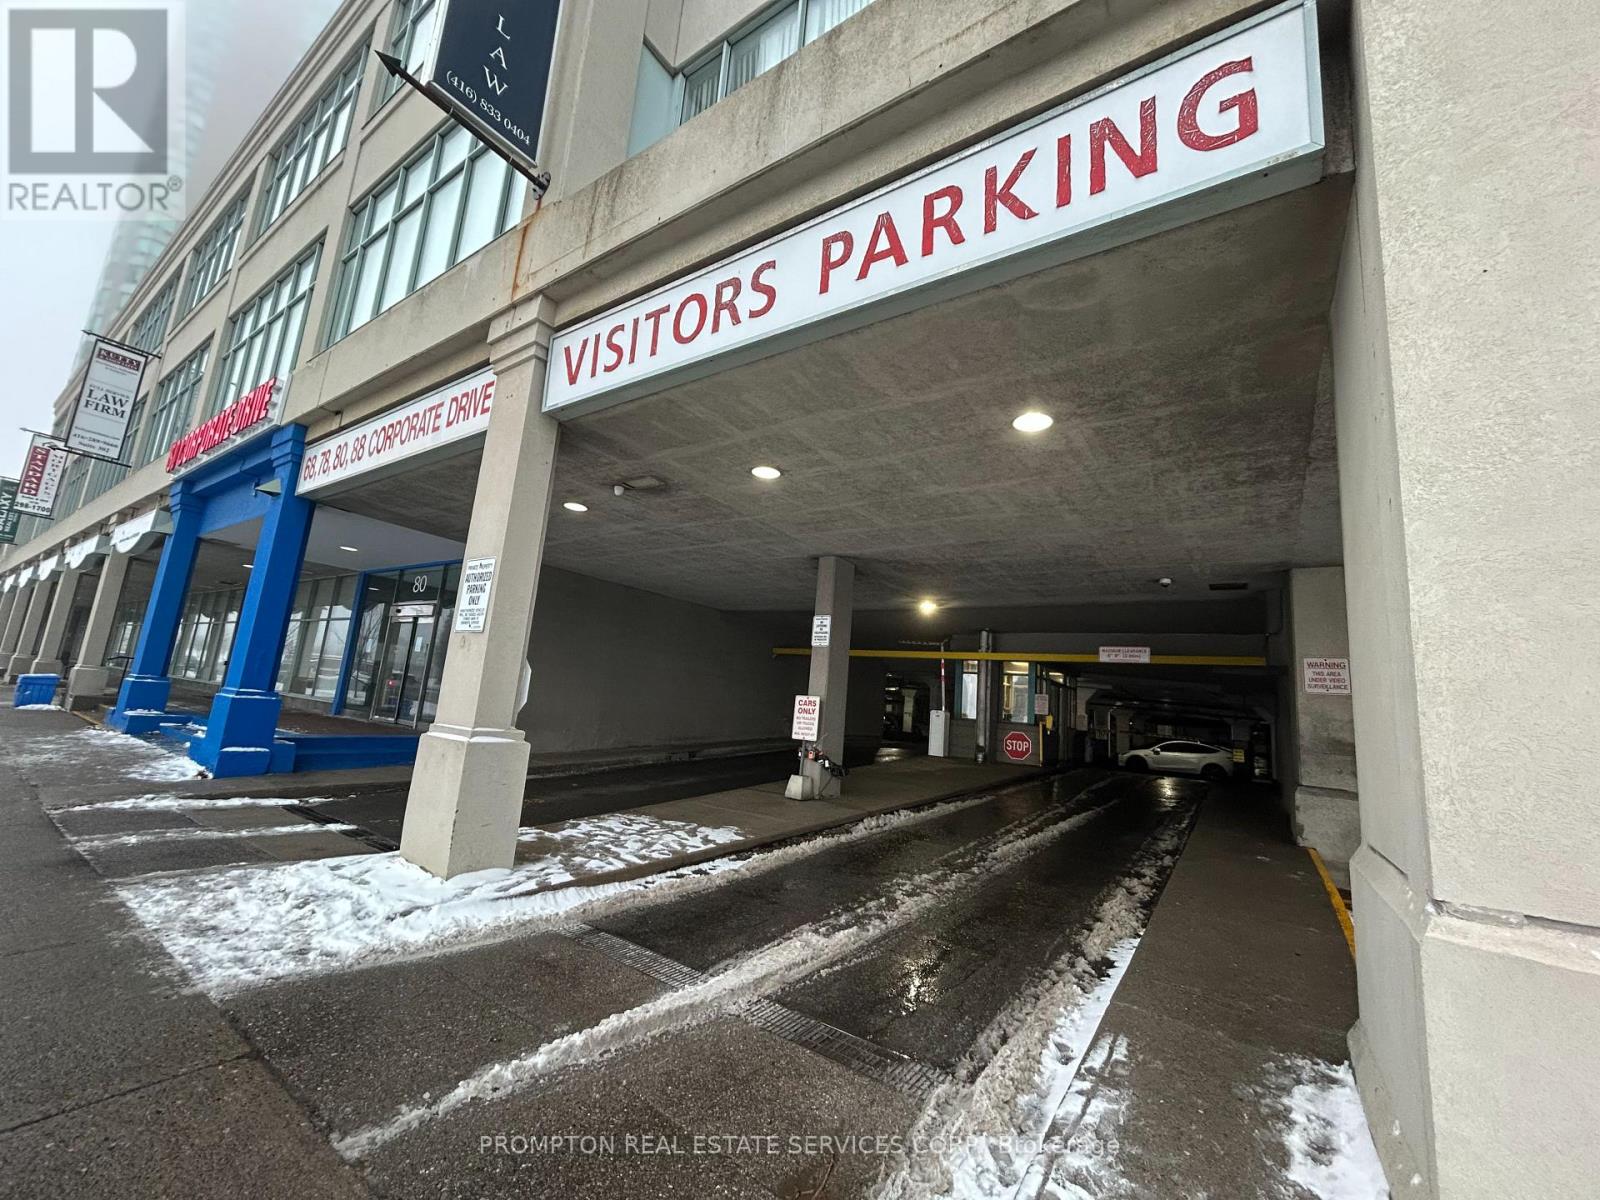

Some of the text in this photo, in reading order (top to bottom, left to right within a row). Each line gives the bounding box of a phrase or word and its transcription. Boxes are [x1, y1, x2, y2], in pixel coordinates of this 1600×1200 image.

[446, 70, 531, 146] (416) 833 0404
[562, 56, 1261, 386] VISITORS PARKING
[87, 389, 129, 408] LAW
[84, 400, 125, 419] FIRM
[303, 380, 495, 482] 68, 78, 80, 88 CORPORATE DRIVE
[413, 575, 427, 592] 80
[465, 571, 492, 583] AUTHORIZED
[466, 583, 486, 594] PARKING
[468, 595, 481, 606] ONLY
[1306, 661, 1346, 670] WARNING
[798, 699, 817, 708] CARS
[797, 707, 816, 715] ONLY
[1006, 739, 1030, 752] STOP
